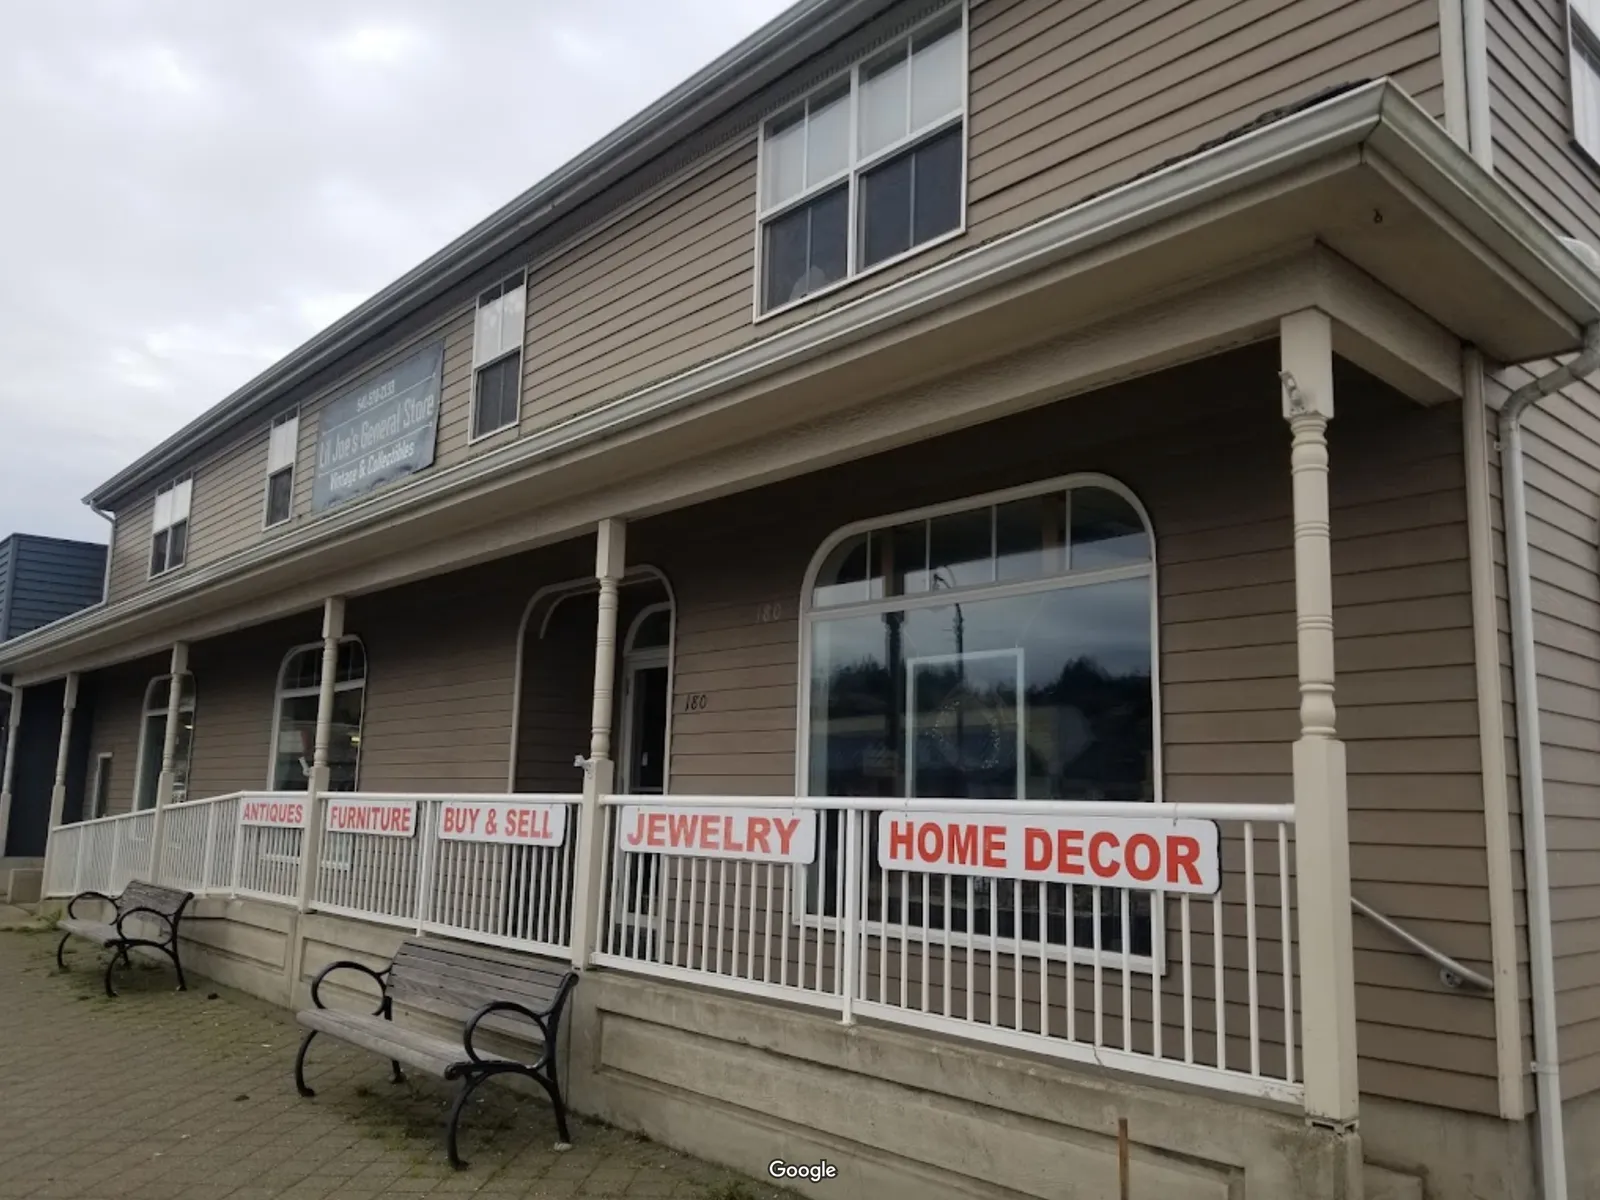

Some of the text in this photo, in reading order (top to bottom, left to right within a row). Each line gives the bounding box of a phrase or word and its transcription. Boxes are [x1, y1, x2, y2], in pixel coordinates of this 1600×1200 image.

[332, 427, 359, 462] Joe's
[360, 404, 401, 447] General
[403, 394, 435, 429] Store
[685, 694, 707, 712] 180
[243, 802, 303, 824] ANTIQUES
[330, 805, 412, 832] FURNITURE
[443, 806, 553, 839] BUY & SELL
[627, 812, 801, 856] JEWELRY
[889, 820, 1204, 886] HOME DECOR
